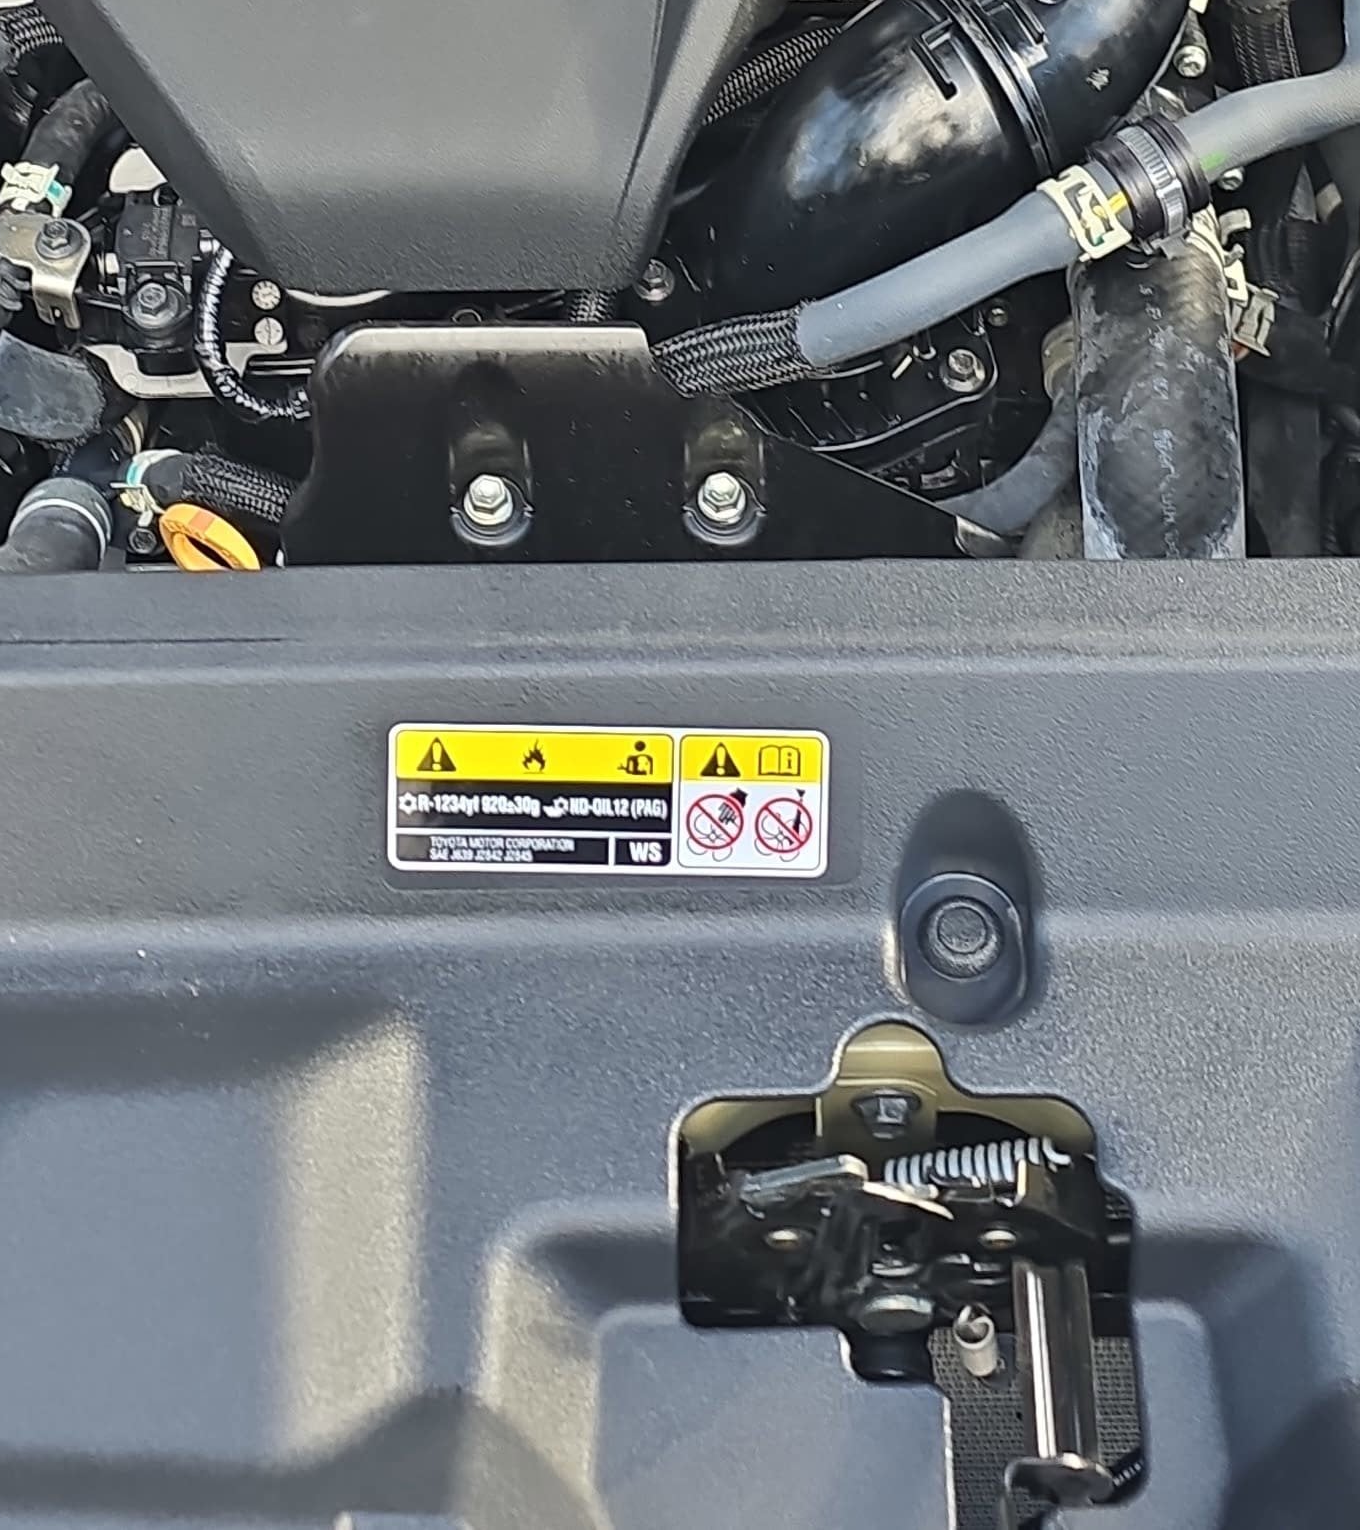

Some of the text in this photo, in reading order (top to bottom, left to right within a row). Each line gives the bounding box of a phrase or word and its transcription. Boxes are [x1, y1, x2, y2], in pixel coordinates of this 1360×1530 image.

[630, 798, 668, 820] (PAG)
[430, 836, 575, 852] TOYOTA MOTOR CORPORATION
[628, 842, 663, 863] WS
